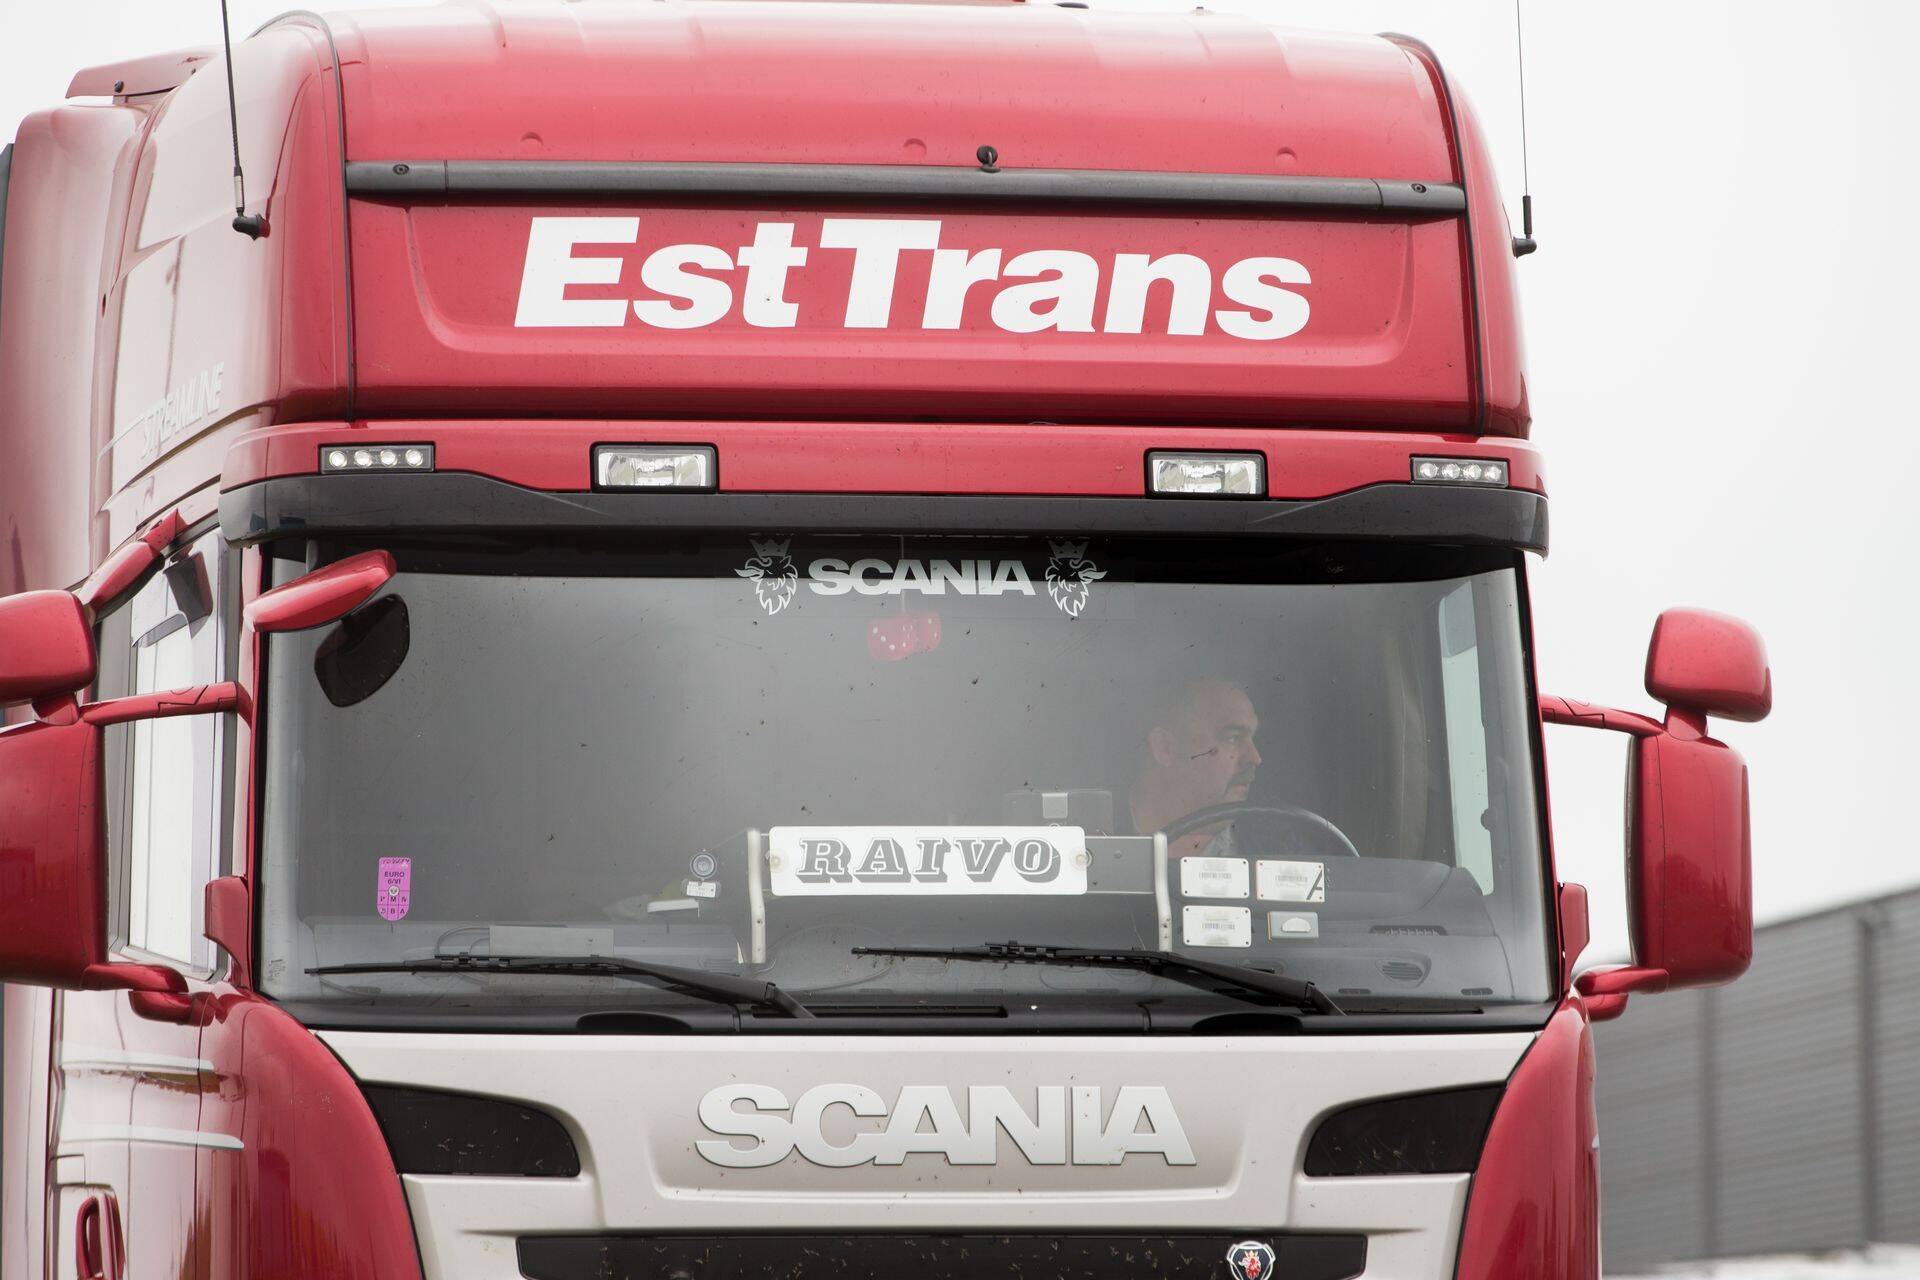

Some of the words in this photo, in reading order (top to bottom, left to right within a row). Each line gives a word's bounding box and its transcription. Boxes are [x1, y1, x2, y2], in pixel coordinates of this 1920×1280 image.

[141, 361, 225, 459] STREAMLINE
[808, 558, 1037, 596] SCANIA
[796, 836, 1062, 884] RAIVO
[695, 1083, 1197, 1168] SCANIA
